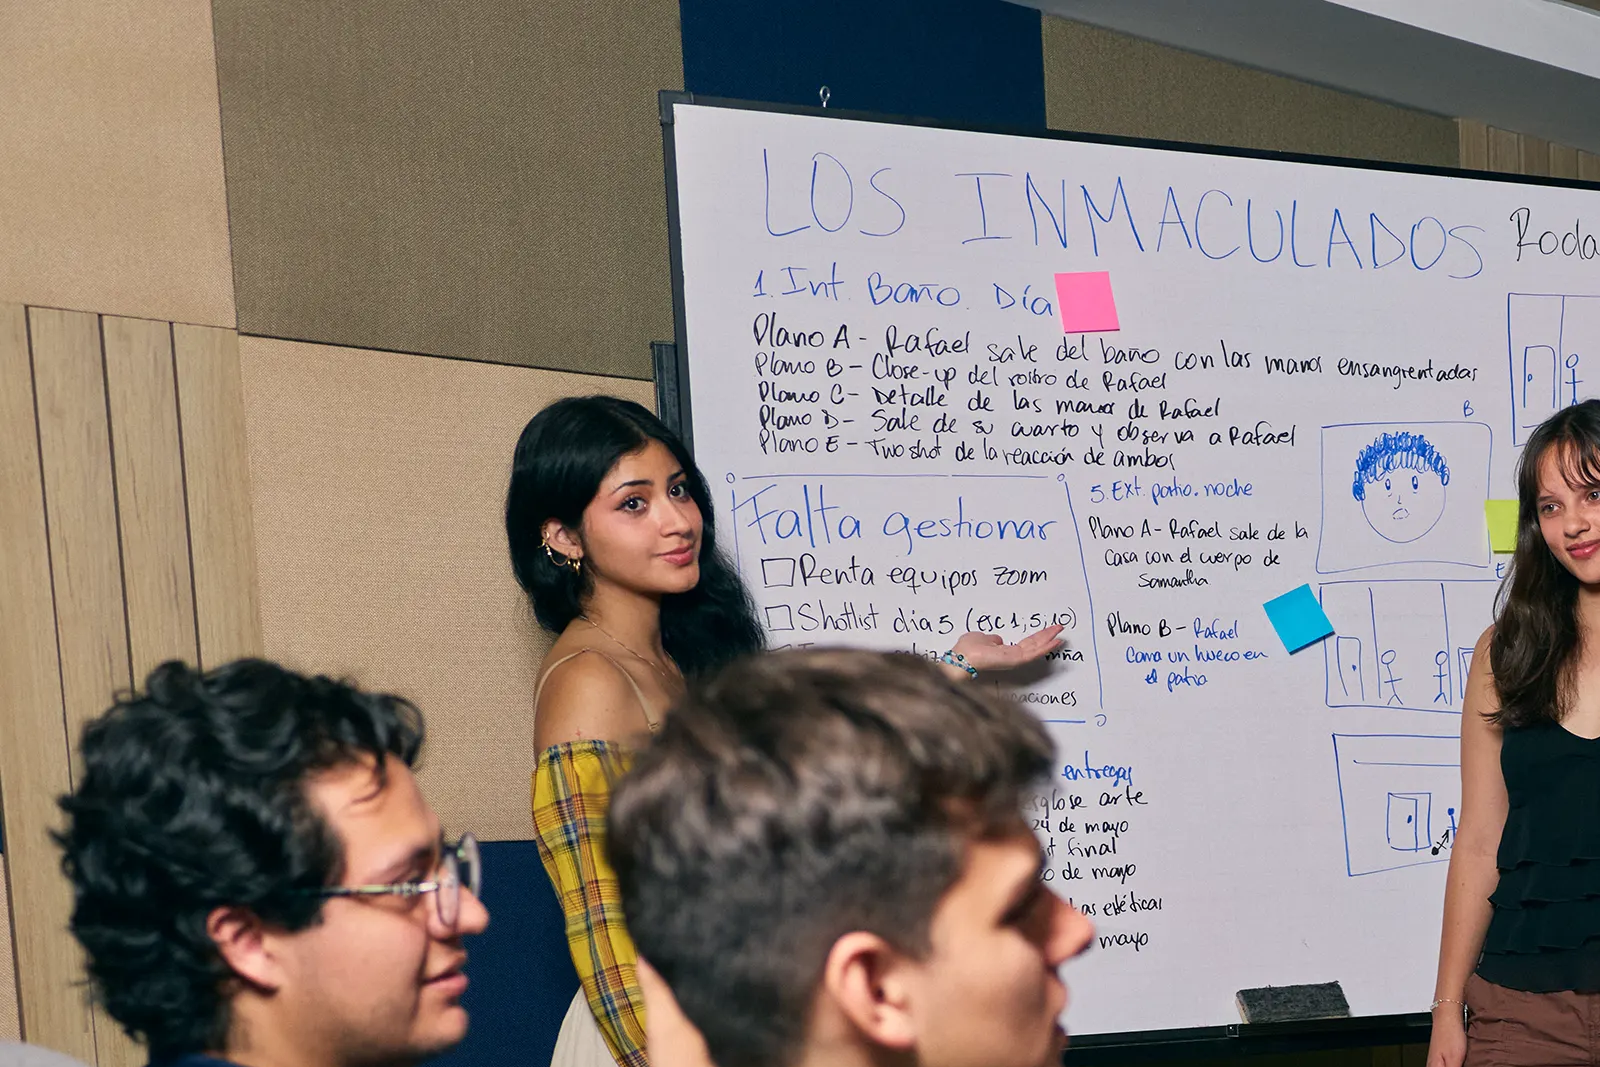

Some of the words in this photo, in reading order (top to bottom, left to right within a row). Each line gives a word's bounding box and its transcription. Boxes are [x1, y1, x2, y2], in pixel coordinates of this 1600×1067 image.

[764, 149, 905, 236] LOS
[954, 171, 1485, 279] INMACULADOS
[753, 312, 825, 348] Plano
[886, 325, 971, 358] Rafael
[986, 334, 1038, 363] sale
[1056, 335, 1089, 362] del
[1100, 338, 1160, 364] baño
[1175, 350, 1215, 370] con
[1221, 340, 1252, 368] las
[1265, 355, 1323, 375] manos
[1337, 357, 1478, 390] ensangrentadas
[754, 351, 816, 377] Plano
[872, 352, 957, 390] Close-up
[968, 365, 998, 386] del
[1066, 370, 1089, 390] de
[1103, 371, 1166, 392] Rafael
[758, 380, 820, 403] Plano
[871, 384, 948, 407] Detalle
[968, 390, 994, 411] de
[1014, 390, 1041, 414] las
[1128, 398, 1148, 420] de
[1159, 398, 1220, 420] Rafael
[1463, 400, 1474, 417] B
[759, 404, 812, 430] Plano
[871, 407, 922, 432] Sale
[933, 413, 958, 434] de
[972, 420, 994, 435] su
[1011, 419, 1079, 438] cuarto
[1091, 424, 1104, 449] y
[1209, 432, 1222, 446] a
[1229, 420, 1296, 446] Rafael
[759, 429, 818, 455] Plano
[955, 441, 975, 462] de
[984, 438, 998, 460] la
[1084, 447, 1105, 466] de
[1113, 447, 1175, 470] ambos
[1204, 478, 1253, 498] noche
[732, 484, 861, 548] Falta
[883, 496, 1058, 555] gestionar
[1088, 516, 1134, 539] Plano
[1169, 518, 1222, 540] Rafael
[1229, 523, 1259, 541] sale
[1267, 523, 1285, 541] de
[1295, 521, 1309, 540] la
[1145, 550, 1174, 566] con
[1180, 547, 1192, 564] el
[1199, 551, 1252, 571] cuerpo
[1263, 549, 1281, 566] de
[799, 553, 875, 586] Renta
[886, 566, 978, 595] equipos
[797, 600, 879, 632] Shotlist
[938, 616, 954, 634] 5
[1107, 611, 1151, 637] Plano
[1193, 617, 1238, 640] Rafael
[1168, 650, 1190, 663] un
[1168, 666, 1208, 692] patio
[1062, 750, 1133, 787] entregas
[1099, 785, 1148, 807] arte
[1059, 817, 1076, 833] de
[1085, 819, 1129, 838] mayo
[1068, 837, 1117, 858] final
[1062, 862, 1083, 880] de
[1091, 863, 1136, 884] mayo
[1100, 932, 1149, 951] mayo
